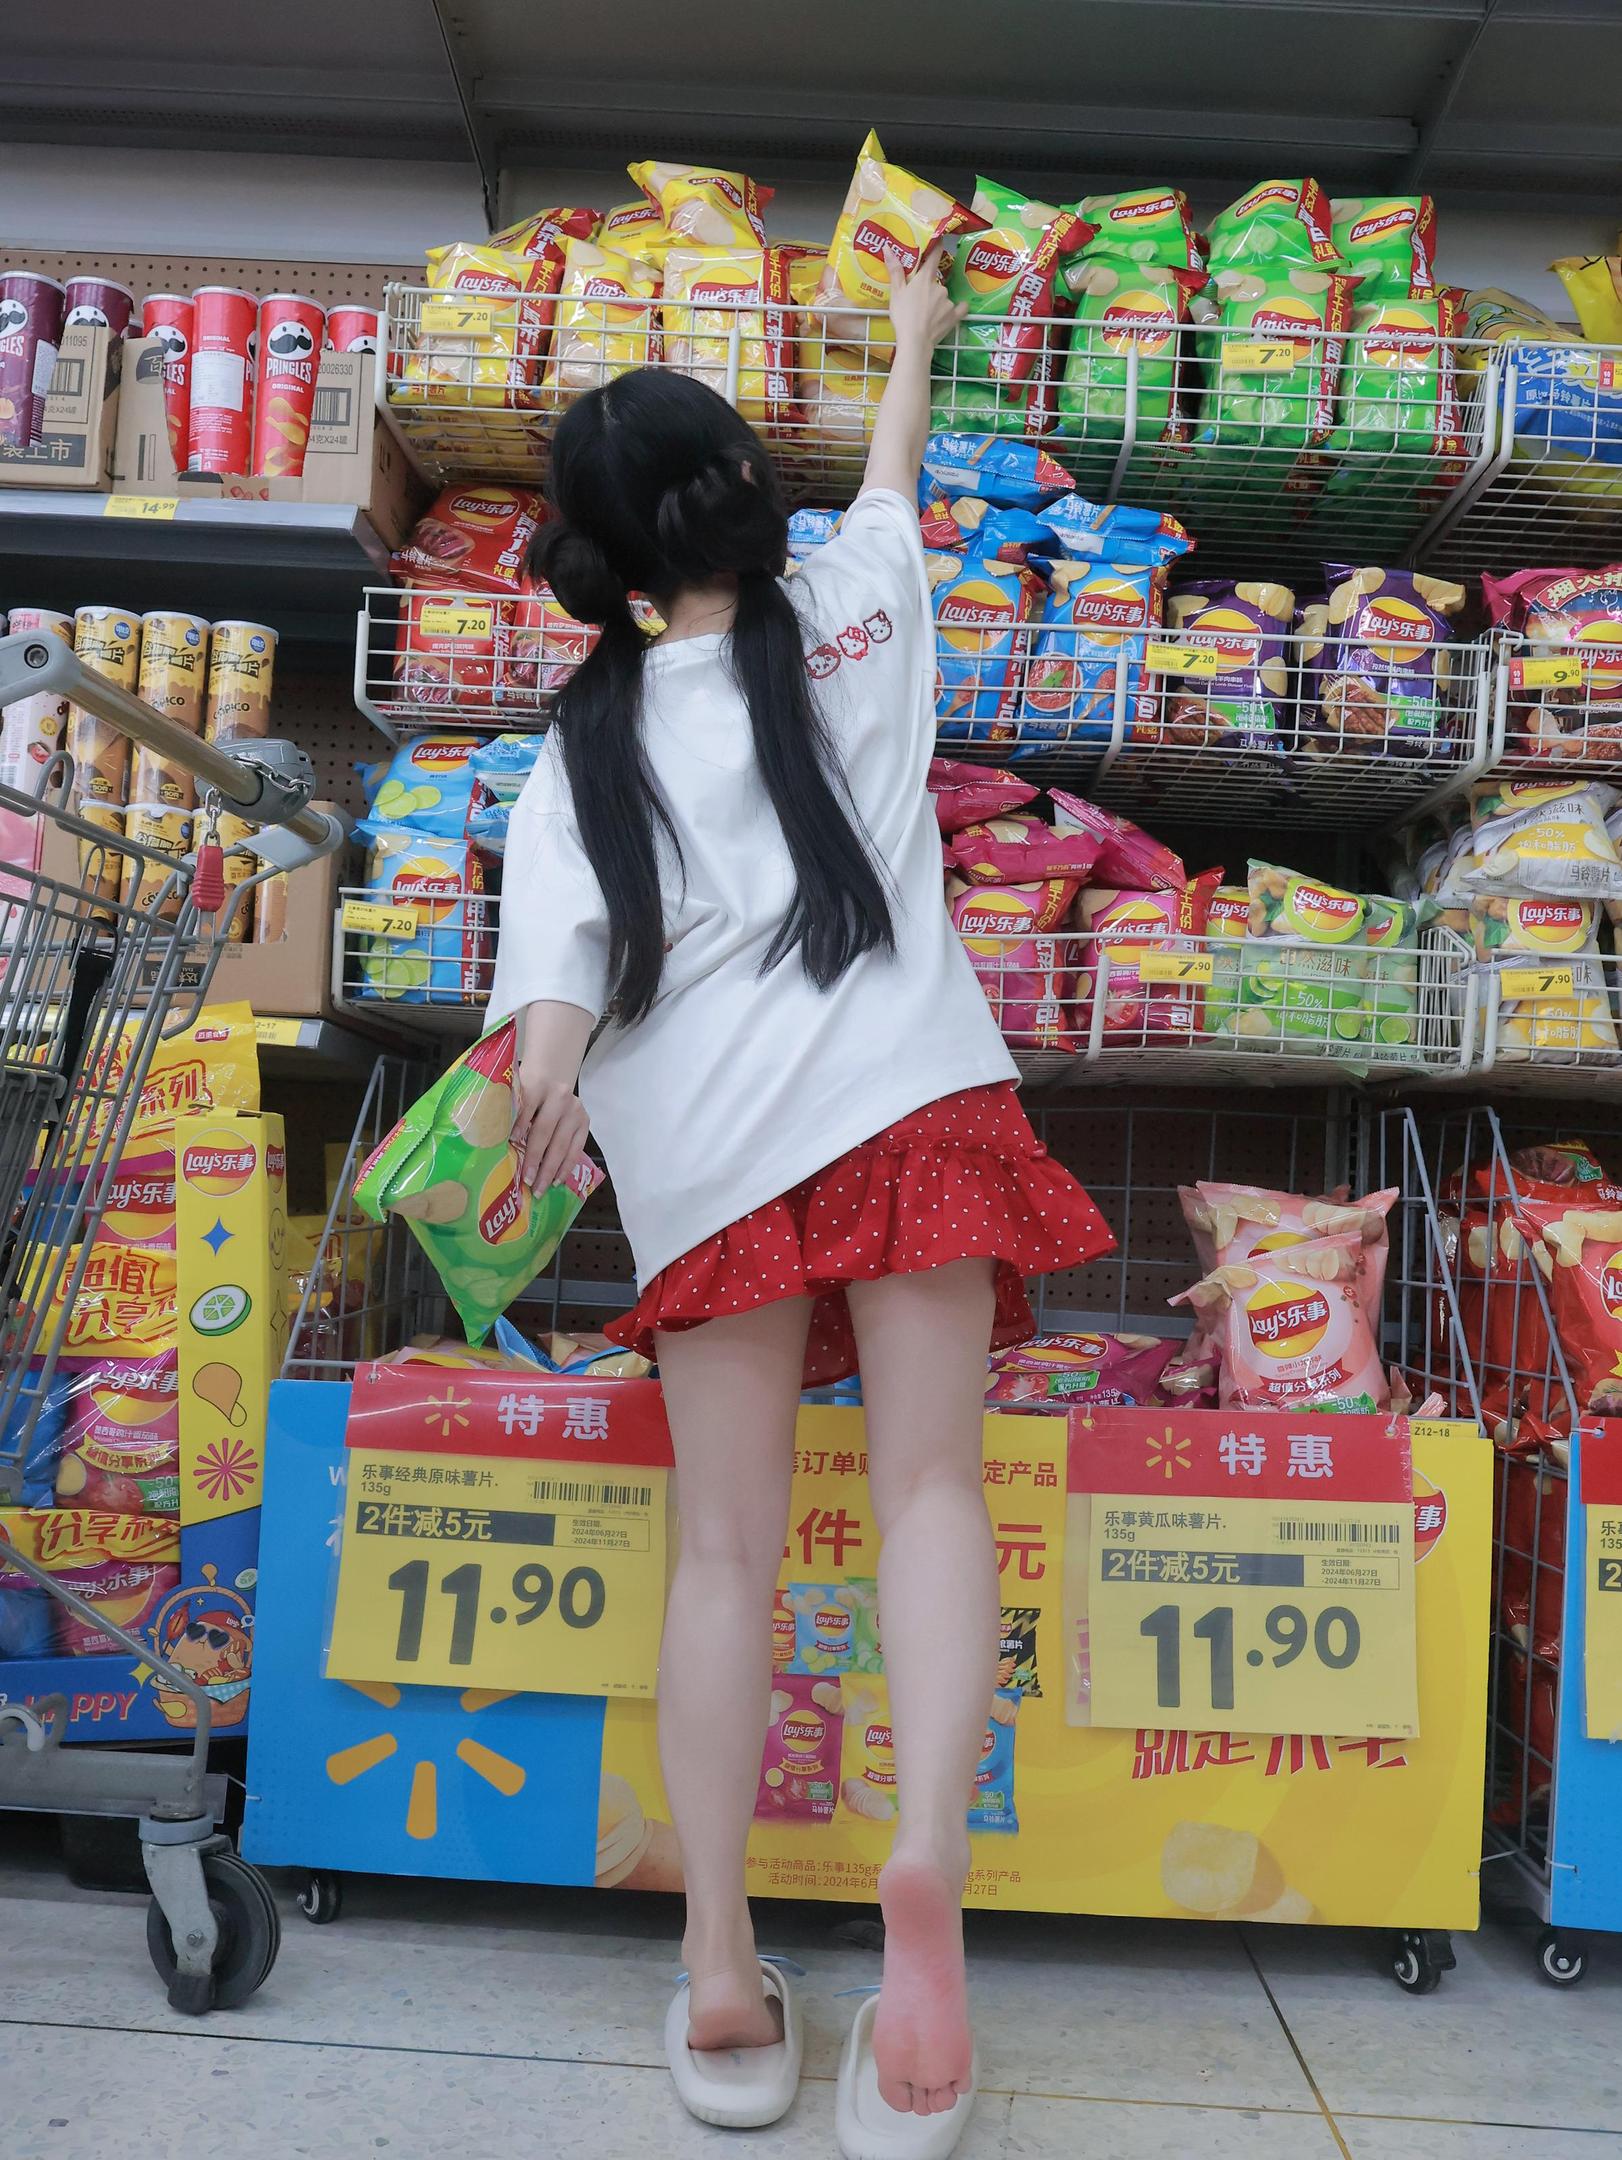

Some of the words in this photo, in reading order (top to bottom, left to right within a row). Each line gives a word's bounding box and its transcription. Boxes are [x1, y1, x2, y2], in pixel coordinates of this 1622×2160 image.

[457, 312, 488, 327] 7.20
[0, 335, 24, 357] GLES
[1260, 349, 1291, 364] 7.20
[266, 357, 312, 384] PRINGLES
[272, 383, 305, 394] ORIGINAL
[141, 501, 175, 515] 14.99
[1074, 597, 1145, 624] Lay's乐事
[457, 619, 486, 635] 7.20
[1362, 615, 1432, 640] Lay's乐事
[1183, 653, 1215, 668] 7.20
[1553, 669, 1580, 683] 9.90
[961, 913, 1033, 935] Lay's乐事
[1522, 906, 1582, 924] Lay's乐事
[382, 917, 412, 933] 7.20
[1179, 961, 1211, 976] 7.90
[1538, 974, 1571, 992] 7.90
[255, 1020, 277, 1030] 2-17
[185, 1152, 256, 1172] Lay's乐事
[1250, 1300, 1328, 1339] Lay's乐事
[497, 1392, 612, 1441] 特惠
[1414, 1426, 1450, 1437] Z12-18
[791, 1451, 868, 1476] 订单
[1218, 1432, 1335, 1479] 特惠
[360, 1481, 392, 1498] 135g
[362, 1502, 493, 1541] 2件减5元
[1413, 1504, 1444, 1532] 事
[782, 1508, 862, 1567] 件
[1103, 1528, 1136, 1544] 135g
[1107, 1552, 1241, 1584] 2件减5元
[1321, 1568, 1378, 1577] 2024年06月27日
[1602, 1562, 1622, 1588] 2
[388, 1558, 606, 1666] 11.90
[1139, 1604, 1361, 1710] 11.90
[783, 1723, 825, 1739] Lay's乐事
[866, 1729, 894, 1745] Lay's
